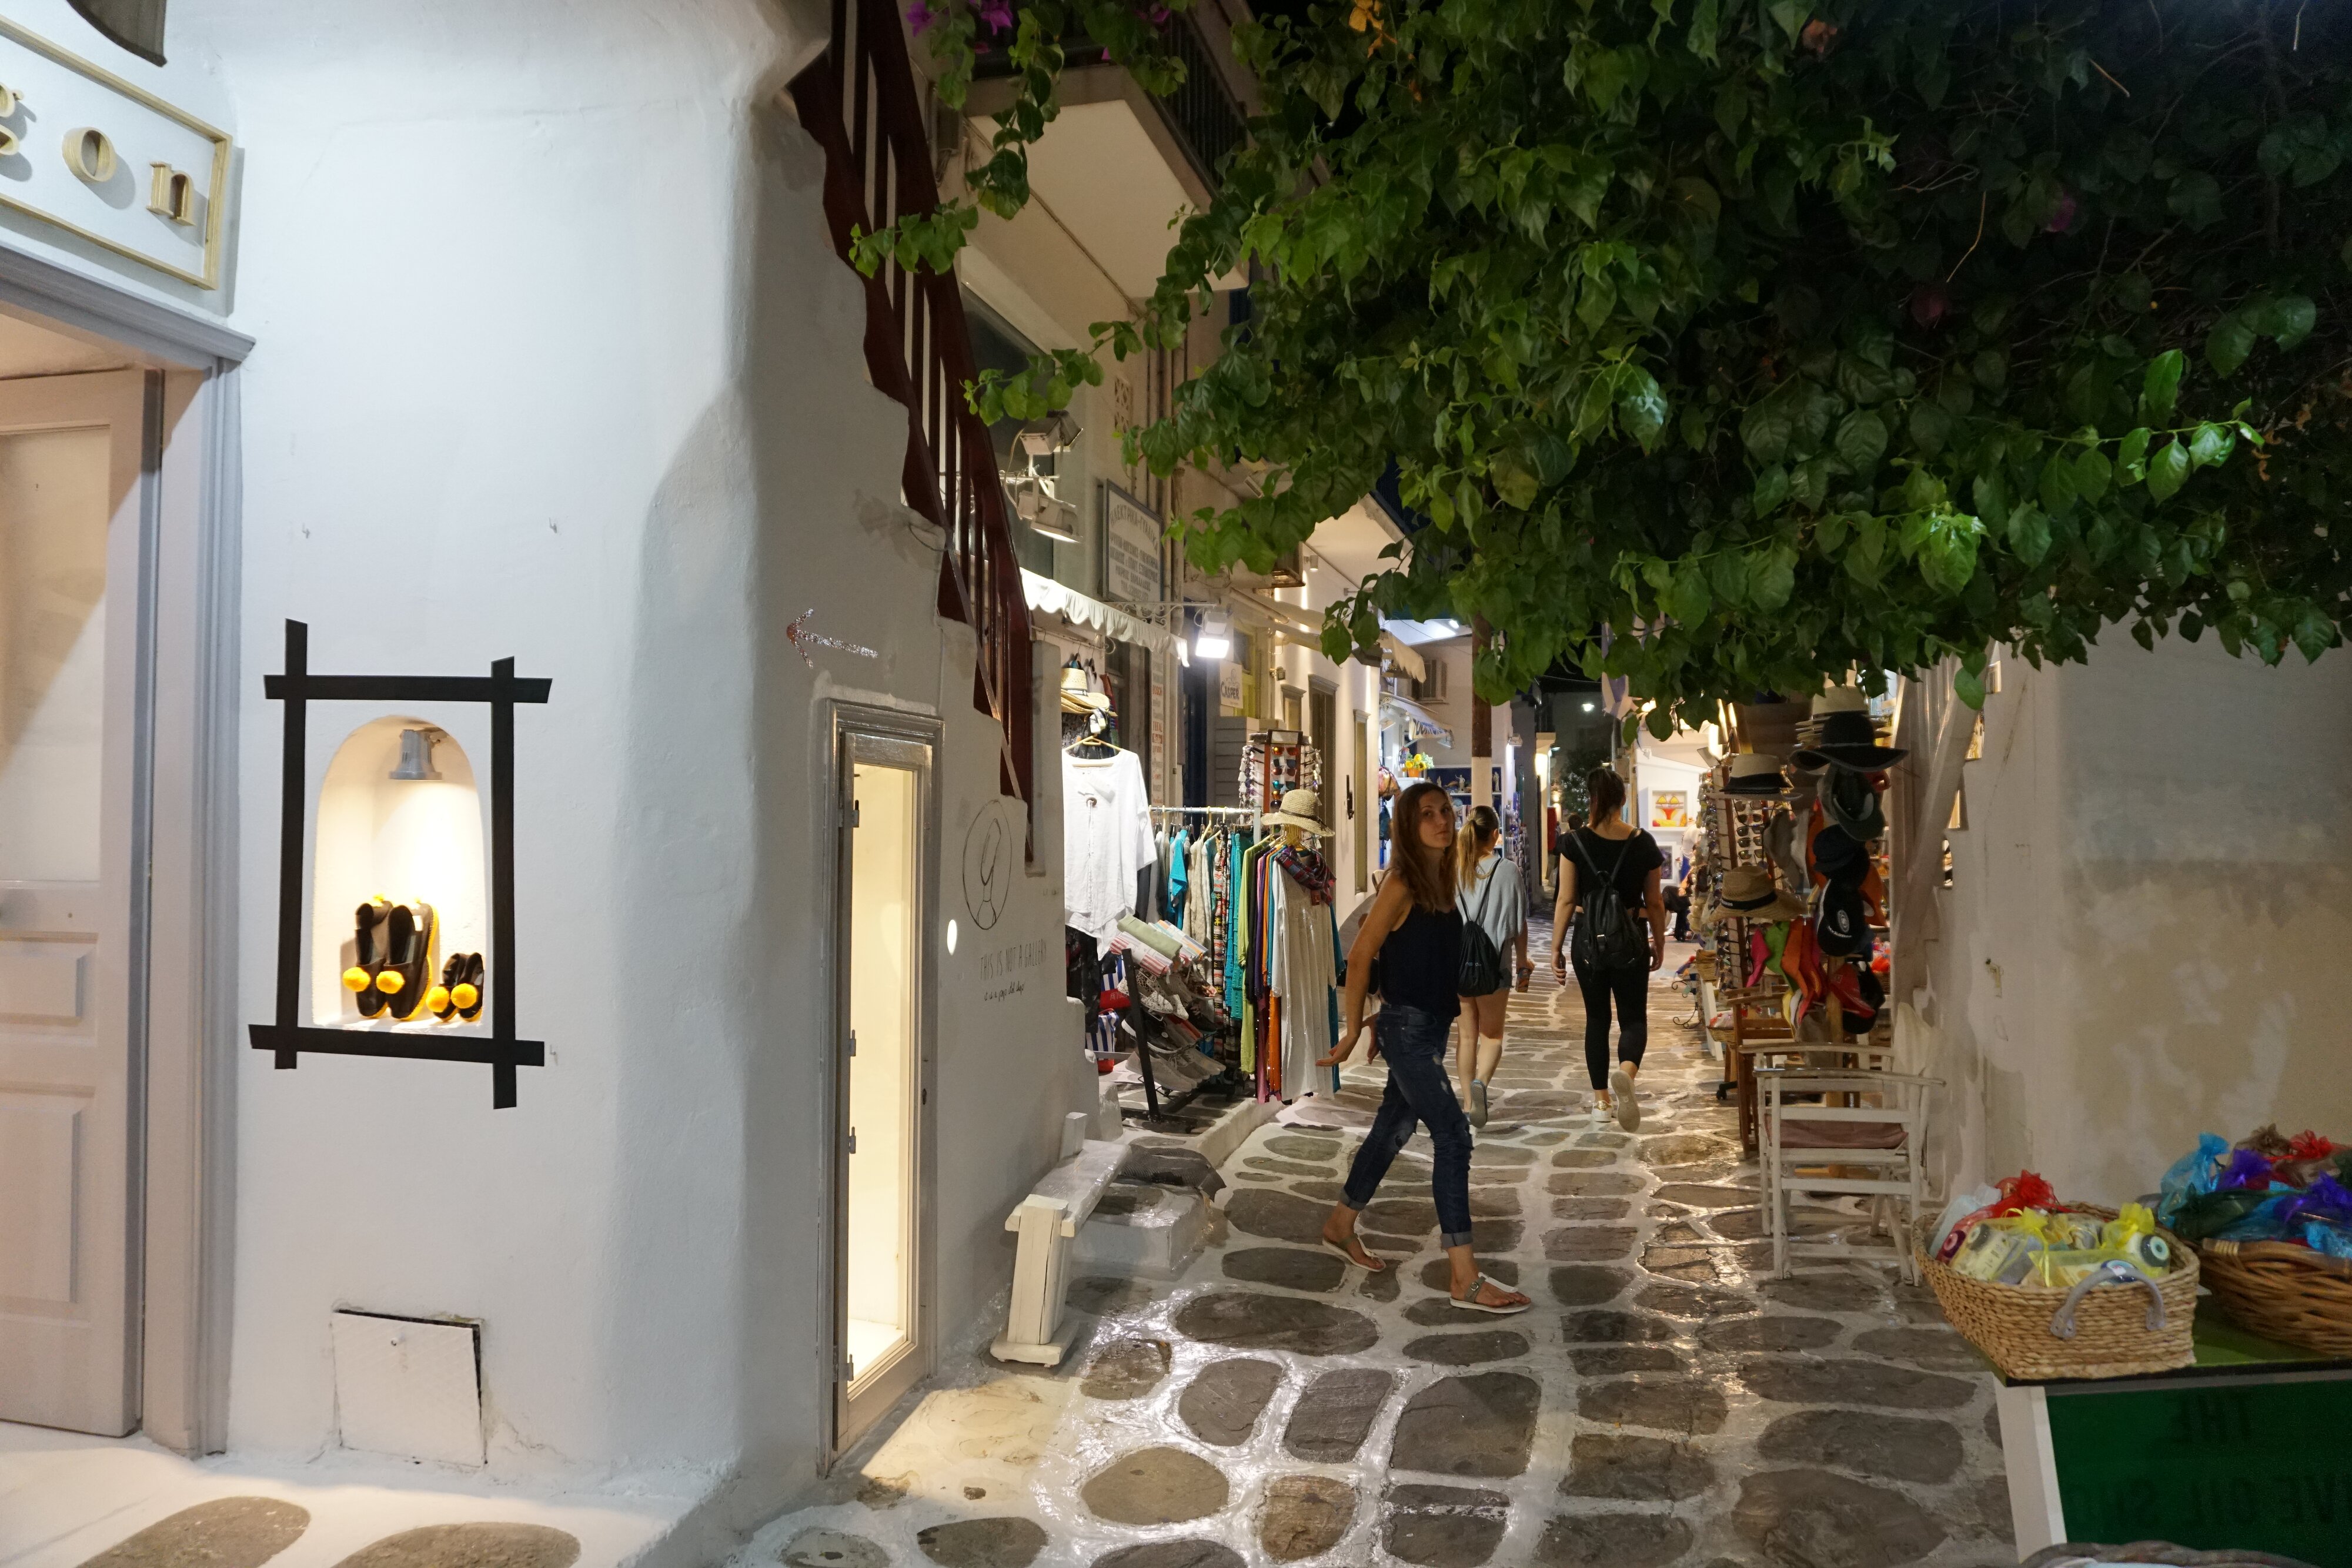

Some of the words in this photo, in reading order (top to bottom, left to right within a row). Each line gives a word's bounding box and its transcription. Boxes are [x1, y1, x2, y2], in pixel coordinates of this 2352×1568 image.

[979, 952, 993, 980] THIS
[997, 950, 1003, 977] IS
[1005, 947, 1017, 974] NOT
[1018, 944, 1022, 969] A
[1024, 938, 1047, 968] GALLERY
